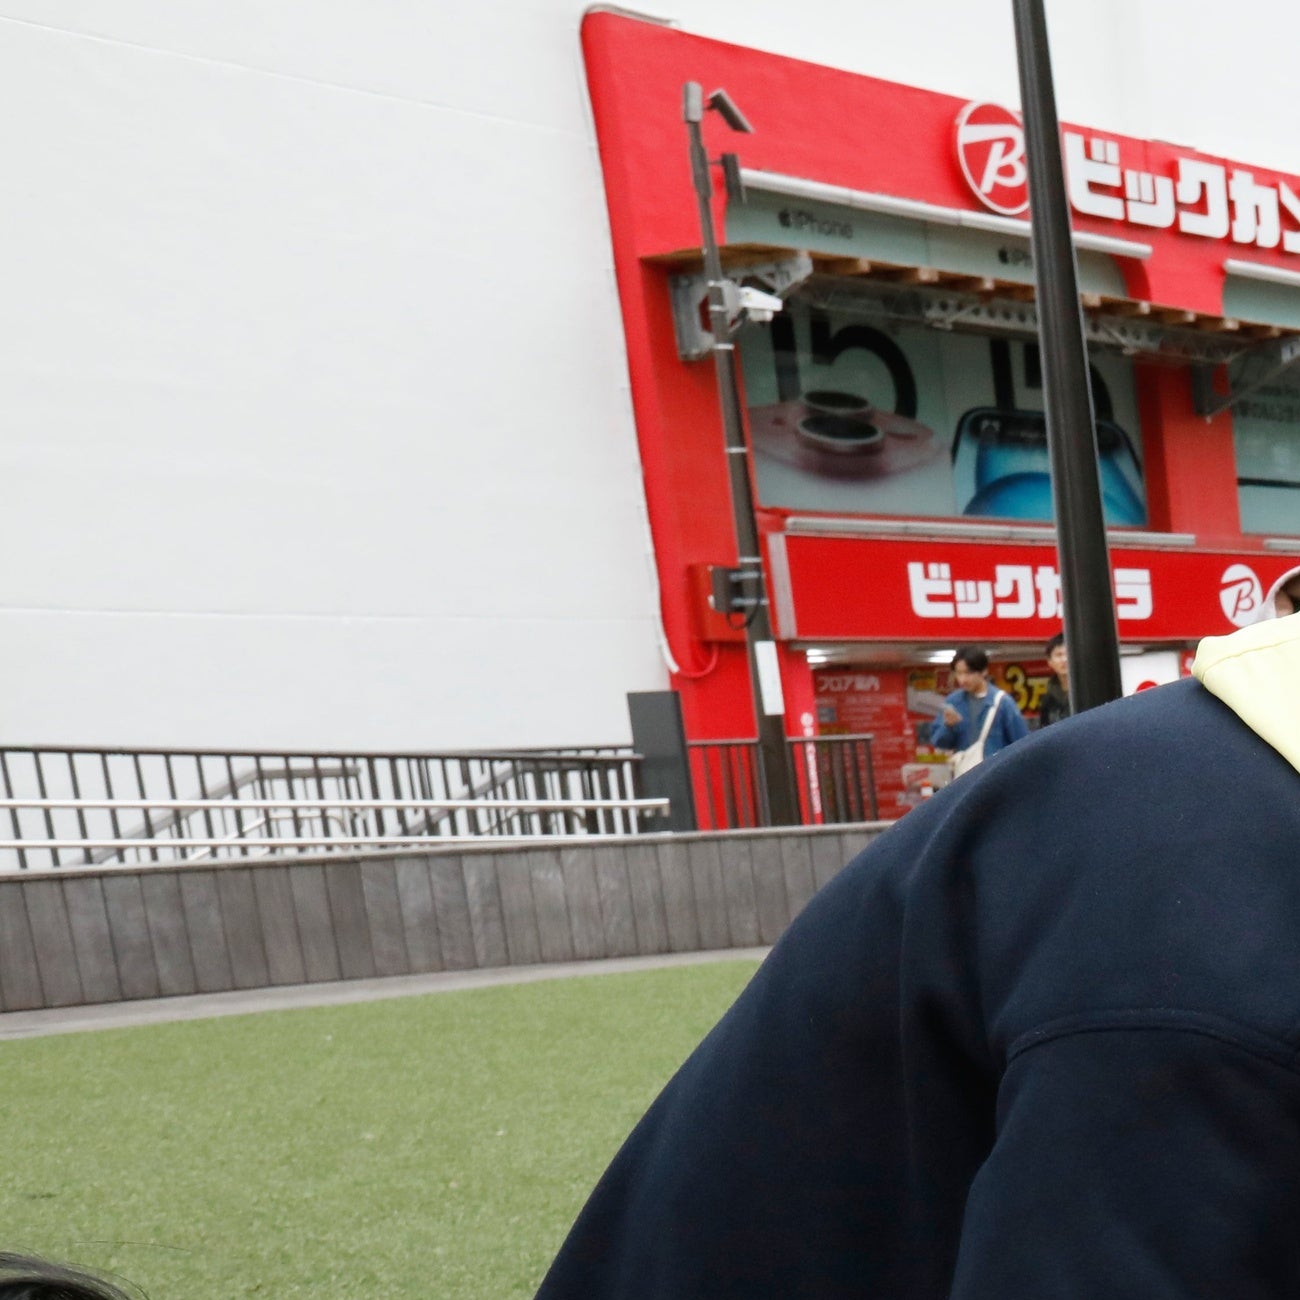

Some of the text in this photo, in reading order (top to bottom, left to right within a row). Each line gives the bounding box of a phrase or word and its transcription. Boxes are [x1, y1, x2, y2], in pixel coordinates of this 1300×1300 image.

[907, 562, 1153, 620] ビックカラ
